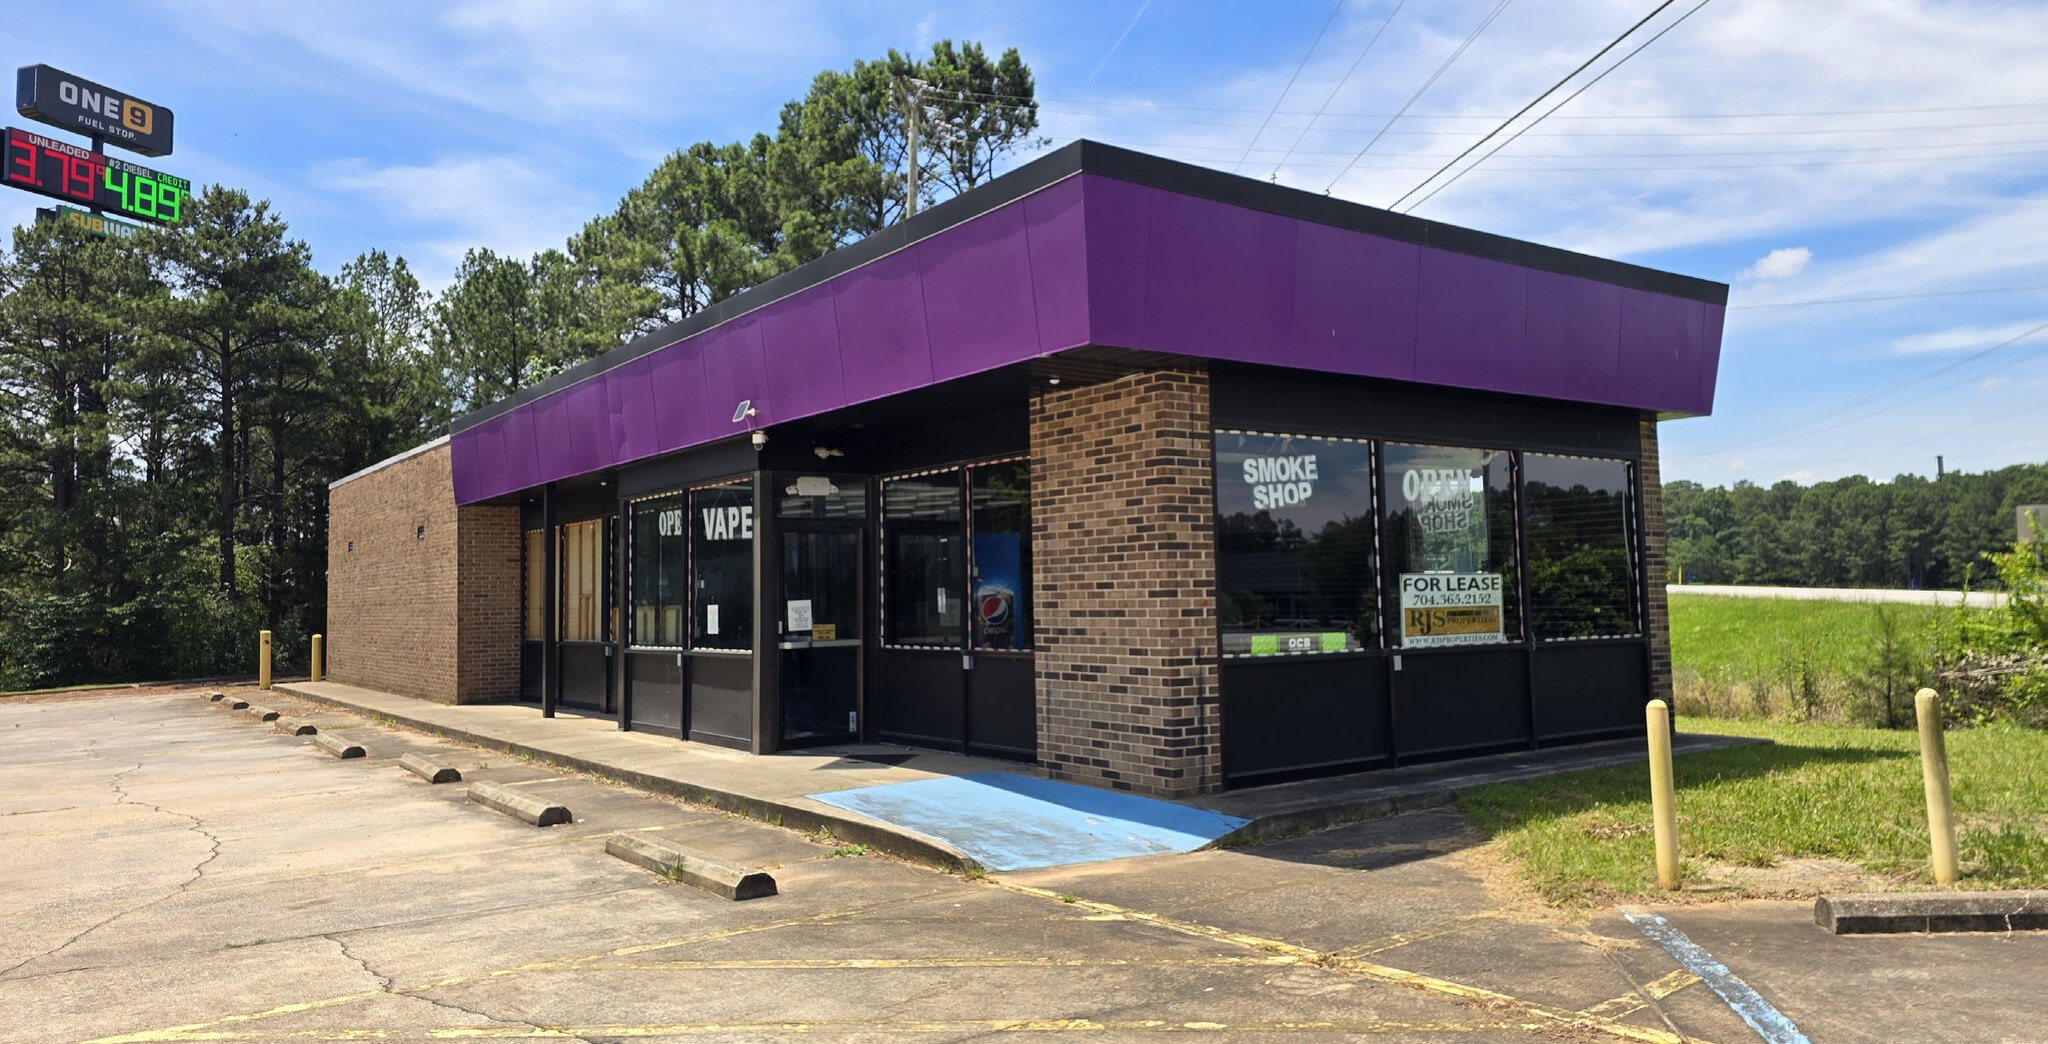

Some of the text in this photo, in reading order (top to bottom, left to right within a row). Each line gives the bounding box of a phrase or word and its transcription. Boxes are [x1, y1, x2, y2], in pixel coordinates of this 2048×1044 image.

[78, 115, 105, 131] FUEL
[28, 134, 90, 160] UNLEADED
[109, 158, 188, 189] #2 DIESEL CREDIT
[68, 212, 137, 239] SUBWA
[1243, 454, 1319, 484] SMOKE
[1253, 482, 1312, 510] SHOP
[1402, 469, 1472, 502] OPEN
[658, 509, 682, 536] OPE
[702, 506, 753, 540] VAPE
[1403, 576, 1500, 592] FOR LEASE
[1412, 593, 1492, 606] 704.365.2152
[1410, 609, 1447, 635] RJS
[1288, 637, 1311, 648] OCB
